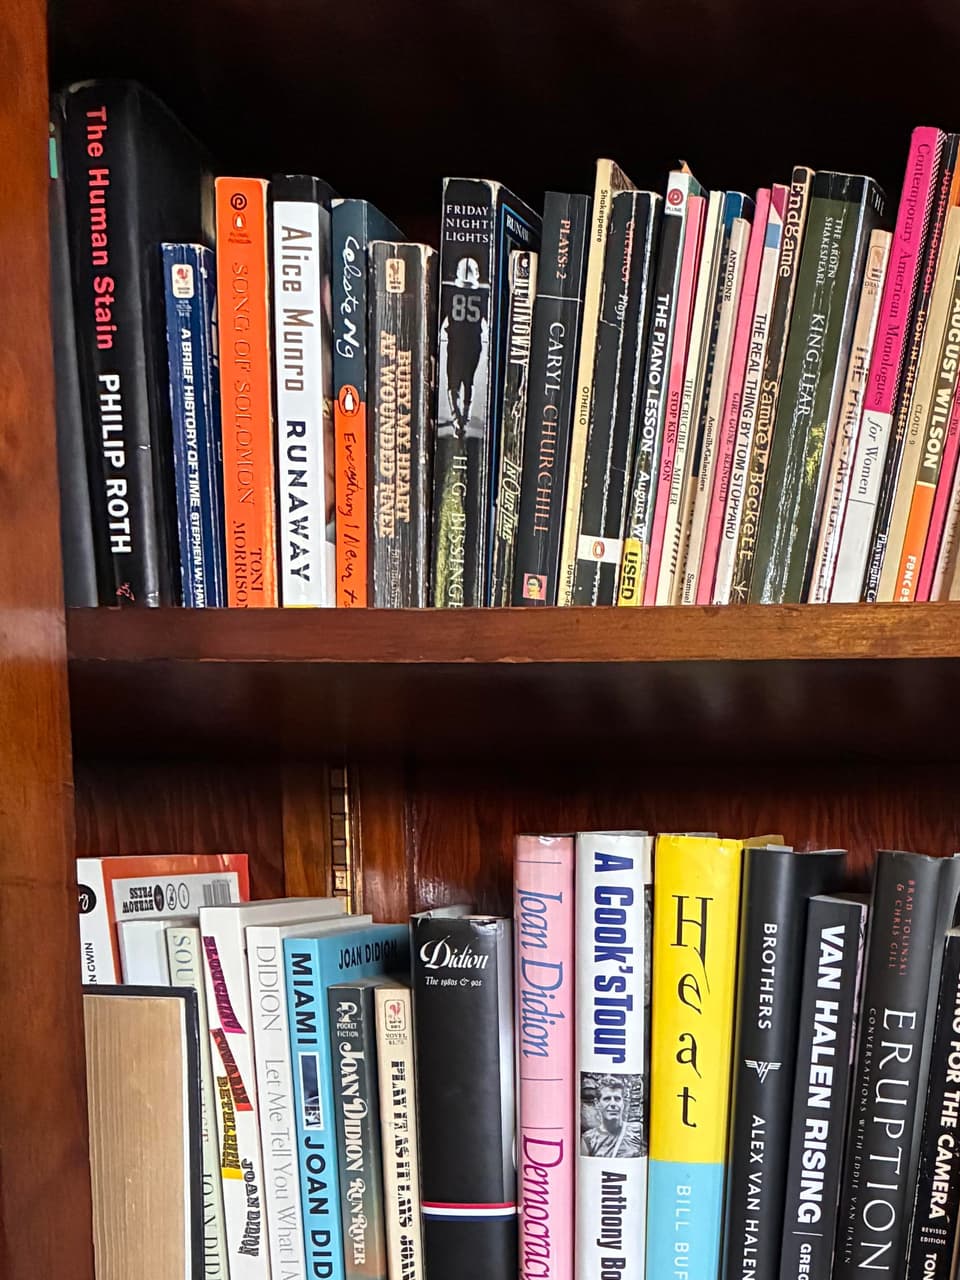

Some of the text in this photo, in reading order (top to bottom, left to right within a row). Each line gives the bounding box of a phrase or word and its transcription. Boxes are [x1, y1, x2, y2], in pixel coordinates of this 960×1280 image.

[86, 105, 117, 350] The Human Stain
[445, 231, 489, 243] LIGHTS
[446, 205, 489, 216] FRIDAY
[446, 218, 489, 229] NIGHT
[779, 183, 805, 278] Endgame
[452, 294, 481, 322] 85
[642, 294, 669, 454] THE PIANO LESSON
[798, 313, 825, 415] KING LEAR
[281, 226, 314, 582] Alice Munro RUNAWAY
[534, 321, 565, 537] CARYL CHURCHILL
[580, 386, 589, 426] OTHELLO
[725, 313, 767, 539] THE REAL THING BY TOM STOPPARD
[923, 394, 952, 469] WILSON
[99, 374, 132, 554] PHILIP ROTH
[621, 552, 638, 600] USED
[594, 852, 634, 873] A
[420, 935, 489, 969] Didion
[517, 887, 562, 949] Joan
[817, 925, 846, 990] VAN
[291, 953, 318, 1045] MIAMI
[521, 957, 565, 1058] Didion
[758, 923, 778, 1030] BROTHERS
[808, 1000, 839, 1109] HALEN
[749, 1115, 766, 1165] ALEX
[857, 1008, 916, 1271] ERUPTION
[940, 1090, 960, 1129] THE
[304, 1136, 329, 1215] JOAN
[596, 1171, 627, 1250] Anthony
[675, 1185, 692, 1232] BILL
[745, 1173, 763, 1210] VAN
[797, 1118, 830, 1224] RISING
[929, 1134, 954, 1219] CAMERA
[920, 1237, 946, 1245] EDITION
